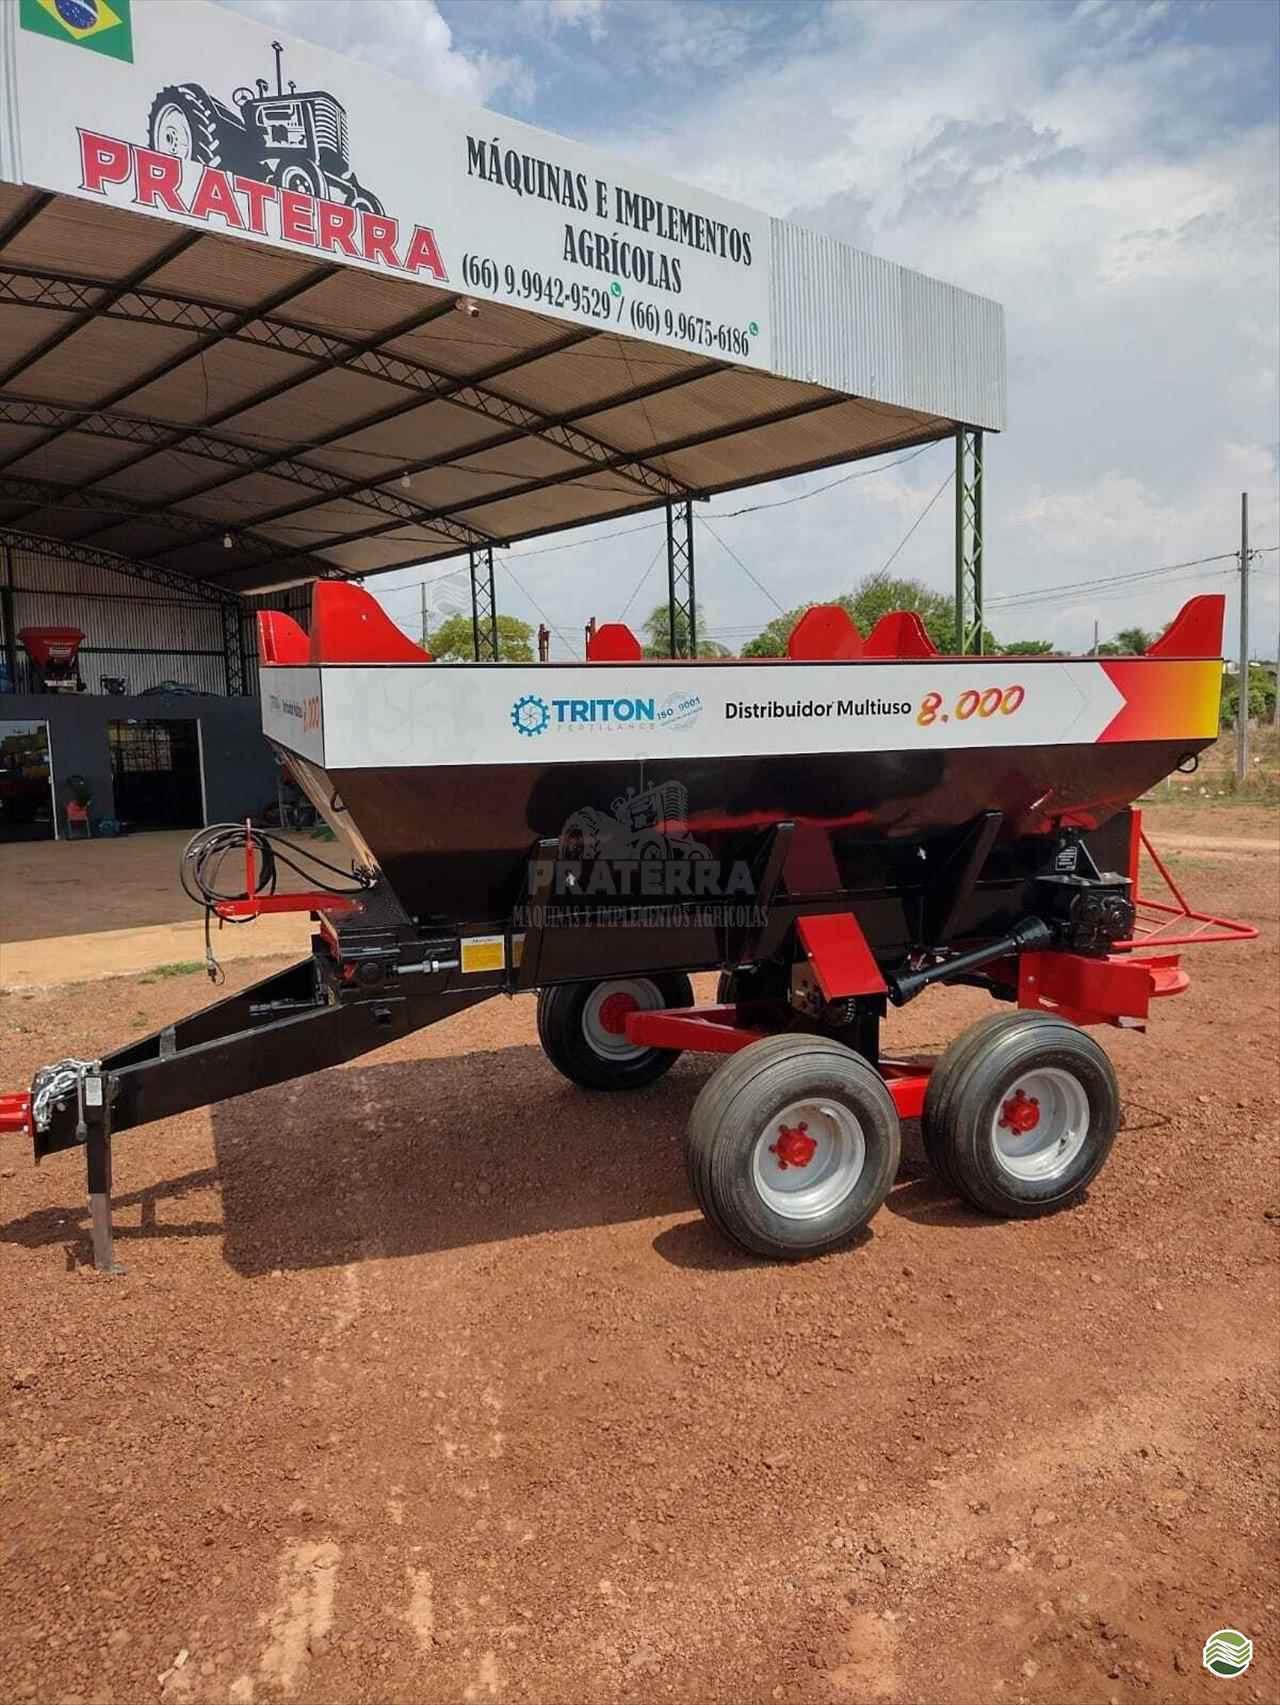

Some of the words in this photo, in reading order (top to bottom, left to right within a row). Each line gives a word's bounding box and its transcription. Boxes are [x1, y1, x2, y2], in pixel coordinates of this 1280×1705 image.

[76, 127, 450, 282] PRATERRA
[465, 136, 589, 213] MÁQUINAS
[594, 179, 609, 218] E
[614, 187, 752, 266] IMPLEMENTOS
[562, 224, 682, 294] AGRÍCOLAS
[462, 253, 499, 293] (66)
[504, 264, 611, 320] 9.9942-9529
[630, 299, 661, 336] (66)
[664, 307, 750, 357] 9.9675-6186
[551, 699, 656, 722] TRITON
[725, 700, 832, 719] Distribuidor
[836, 699, 912, 716] Multiuso
[916, 685, 1025, 727] 8.000
